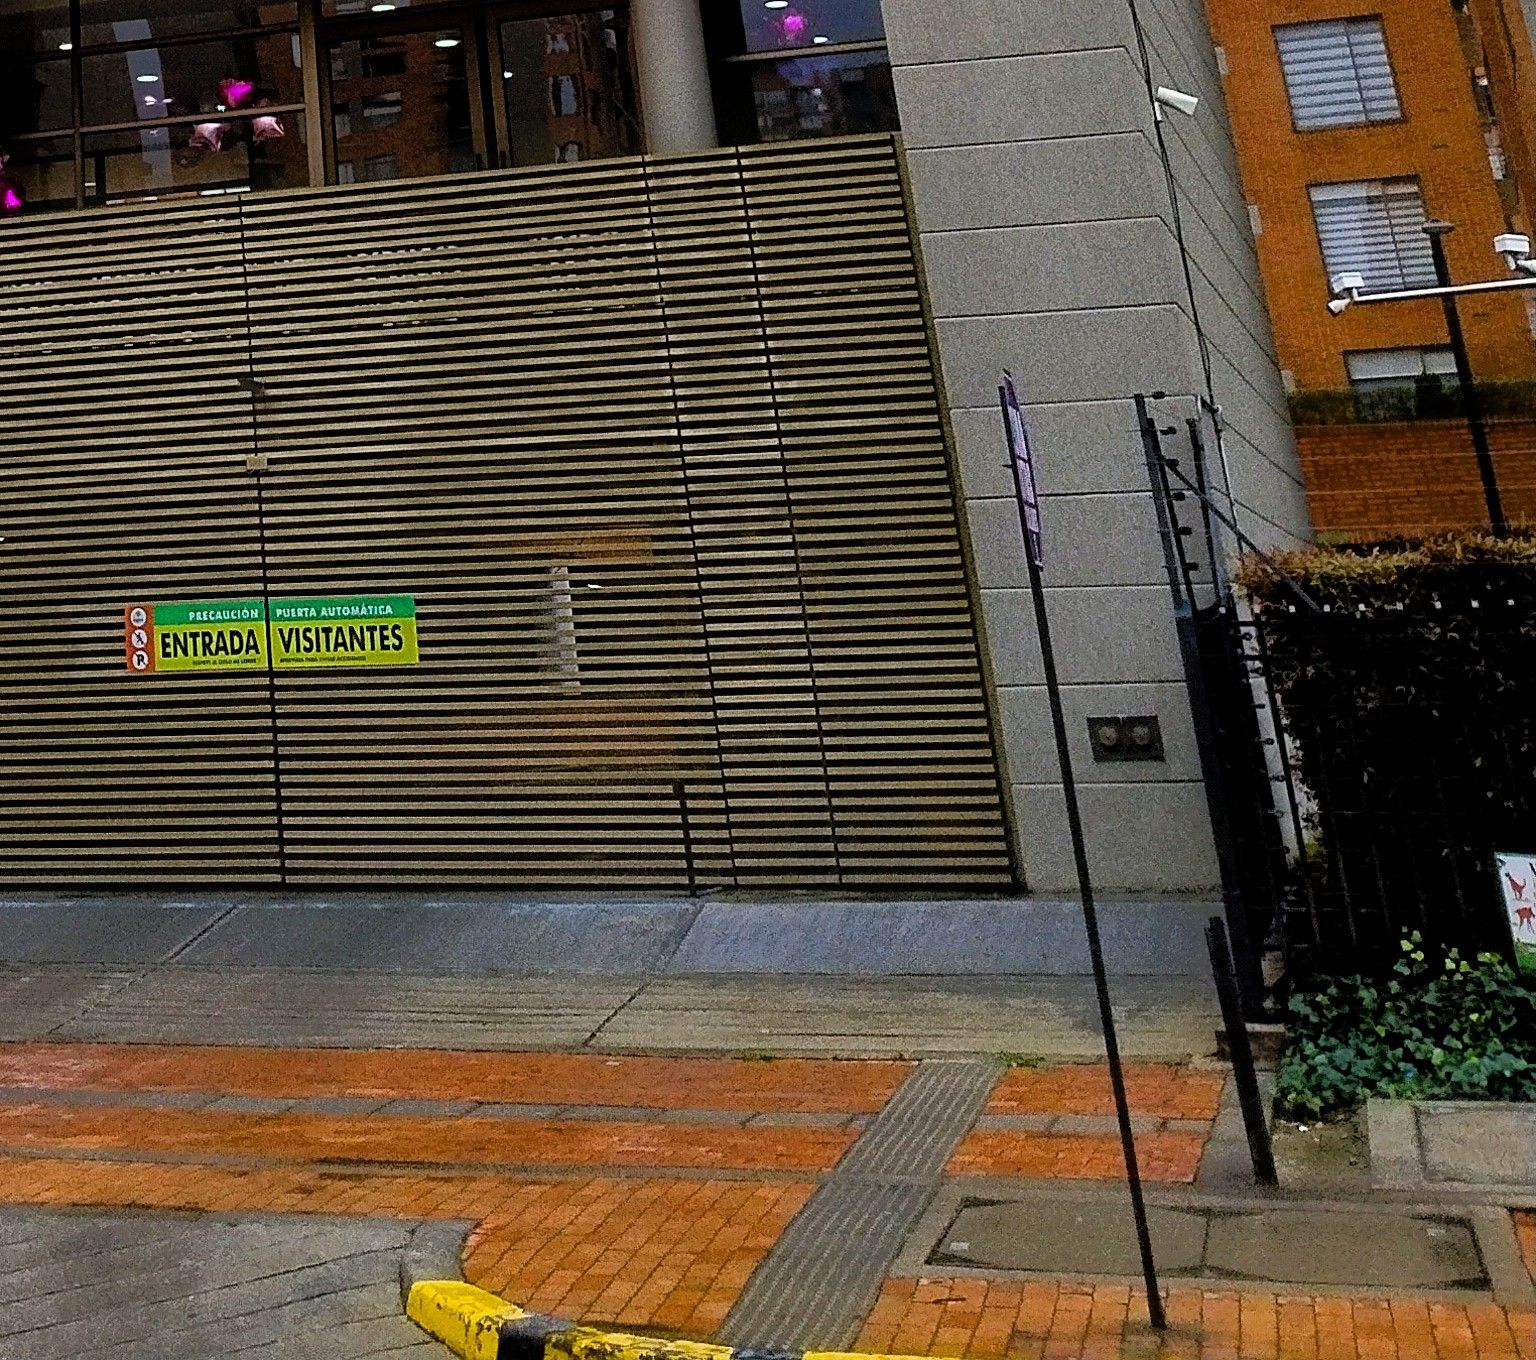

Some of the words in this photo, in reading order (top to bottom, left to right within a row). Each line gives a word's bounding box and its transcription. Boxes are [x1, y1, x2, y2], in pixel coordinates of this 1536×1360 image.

[188, 606, 259, 621] PRECAUCIÓN
[275, 607, 317, 618] PUERTA
[320, 602, 393, 617] AUTOMÁTICA
[160, 628, 261, 659] ENTRADA
[277, 623, 404, 654] VISITANTES
